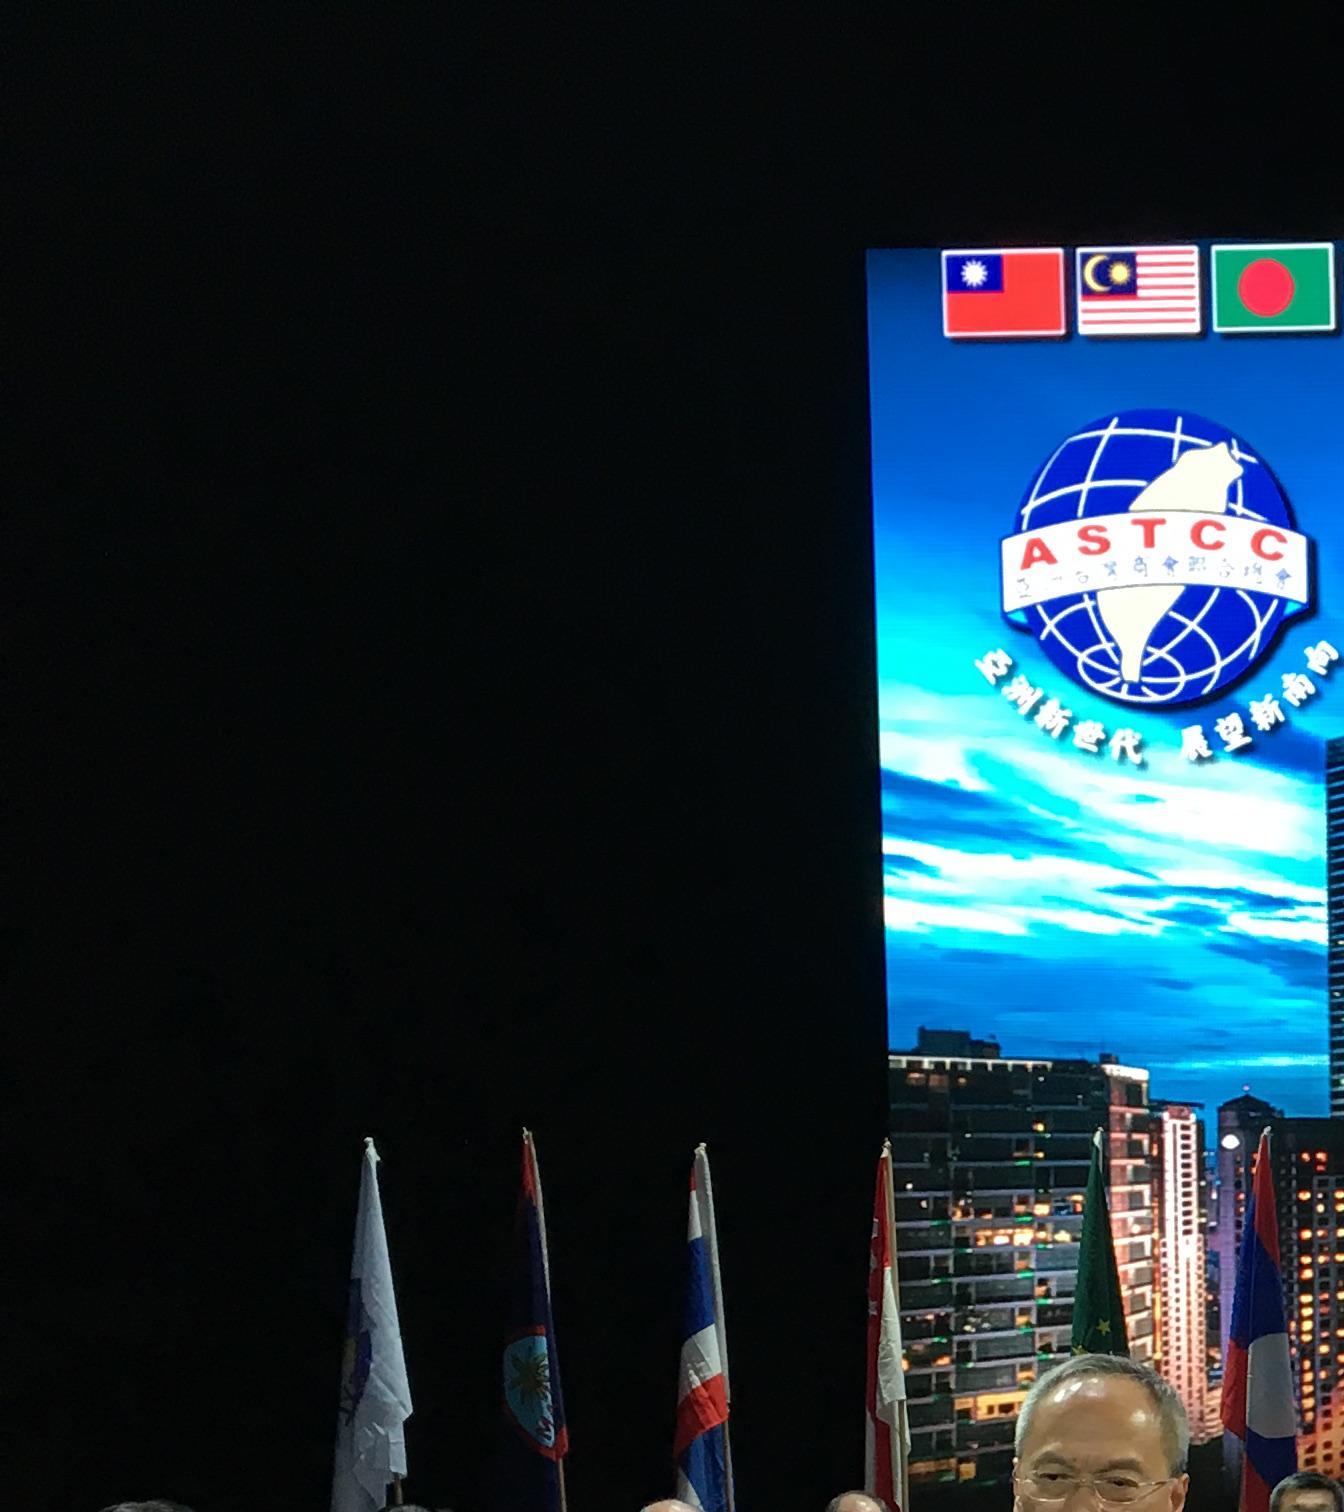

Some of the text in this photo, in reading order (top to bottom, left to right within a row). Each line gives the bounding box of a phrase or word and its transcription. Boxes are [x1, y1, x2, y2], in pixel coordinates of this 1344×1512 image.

[1019, 518, 1289, 570] ASTCC
[974, 639, 1342, 766] 亞洲新世代 展望新南向
